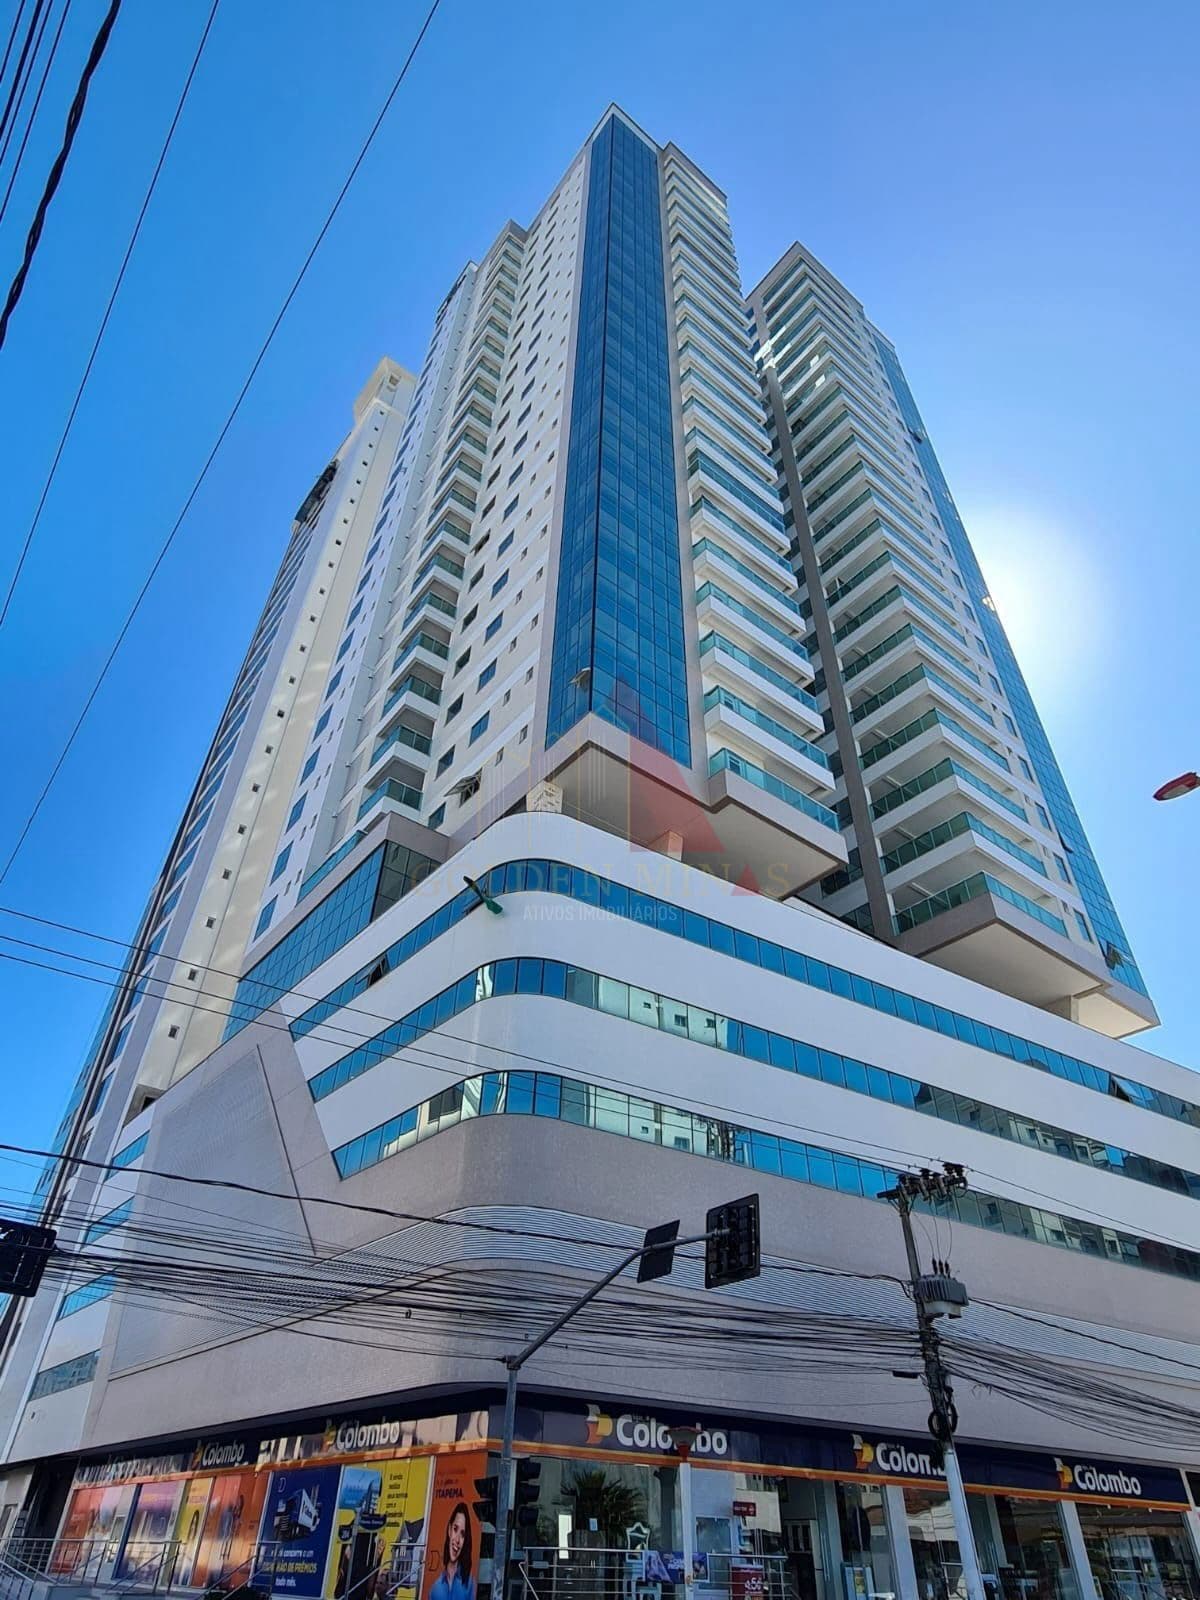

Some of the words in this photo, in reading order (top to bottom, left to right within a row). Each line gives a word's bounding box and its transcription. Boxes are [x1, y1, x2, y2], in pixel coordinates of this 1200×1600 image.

[335, 1416, 400, 1450] Colombo
[616, 1414, 727, 1455] Colobo
[203, 1441, 245, 1466] Colombo
[876, 1442, 946, 1476] Colom
[1074, 1464, 1141, 1495] Colombo
